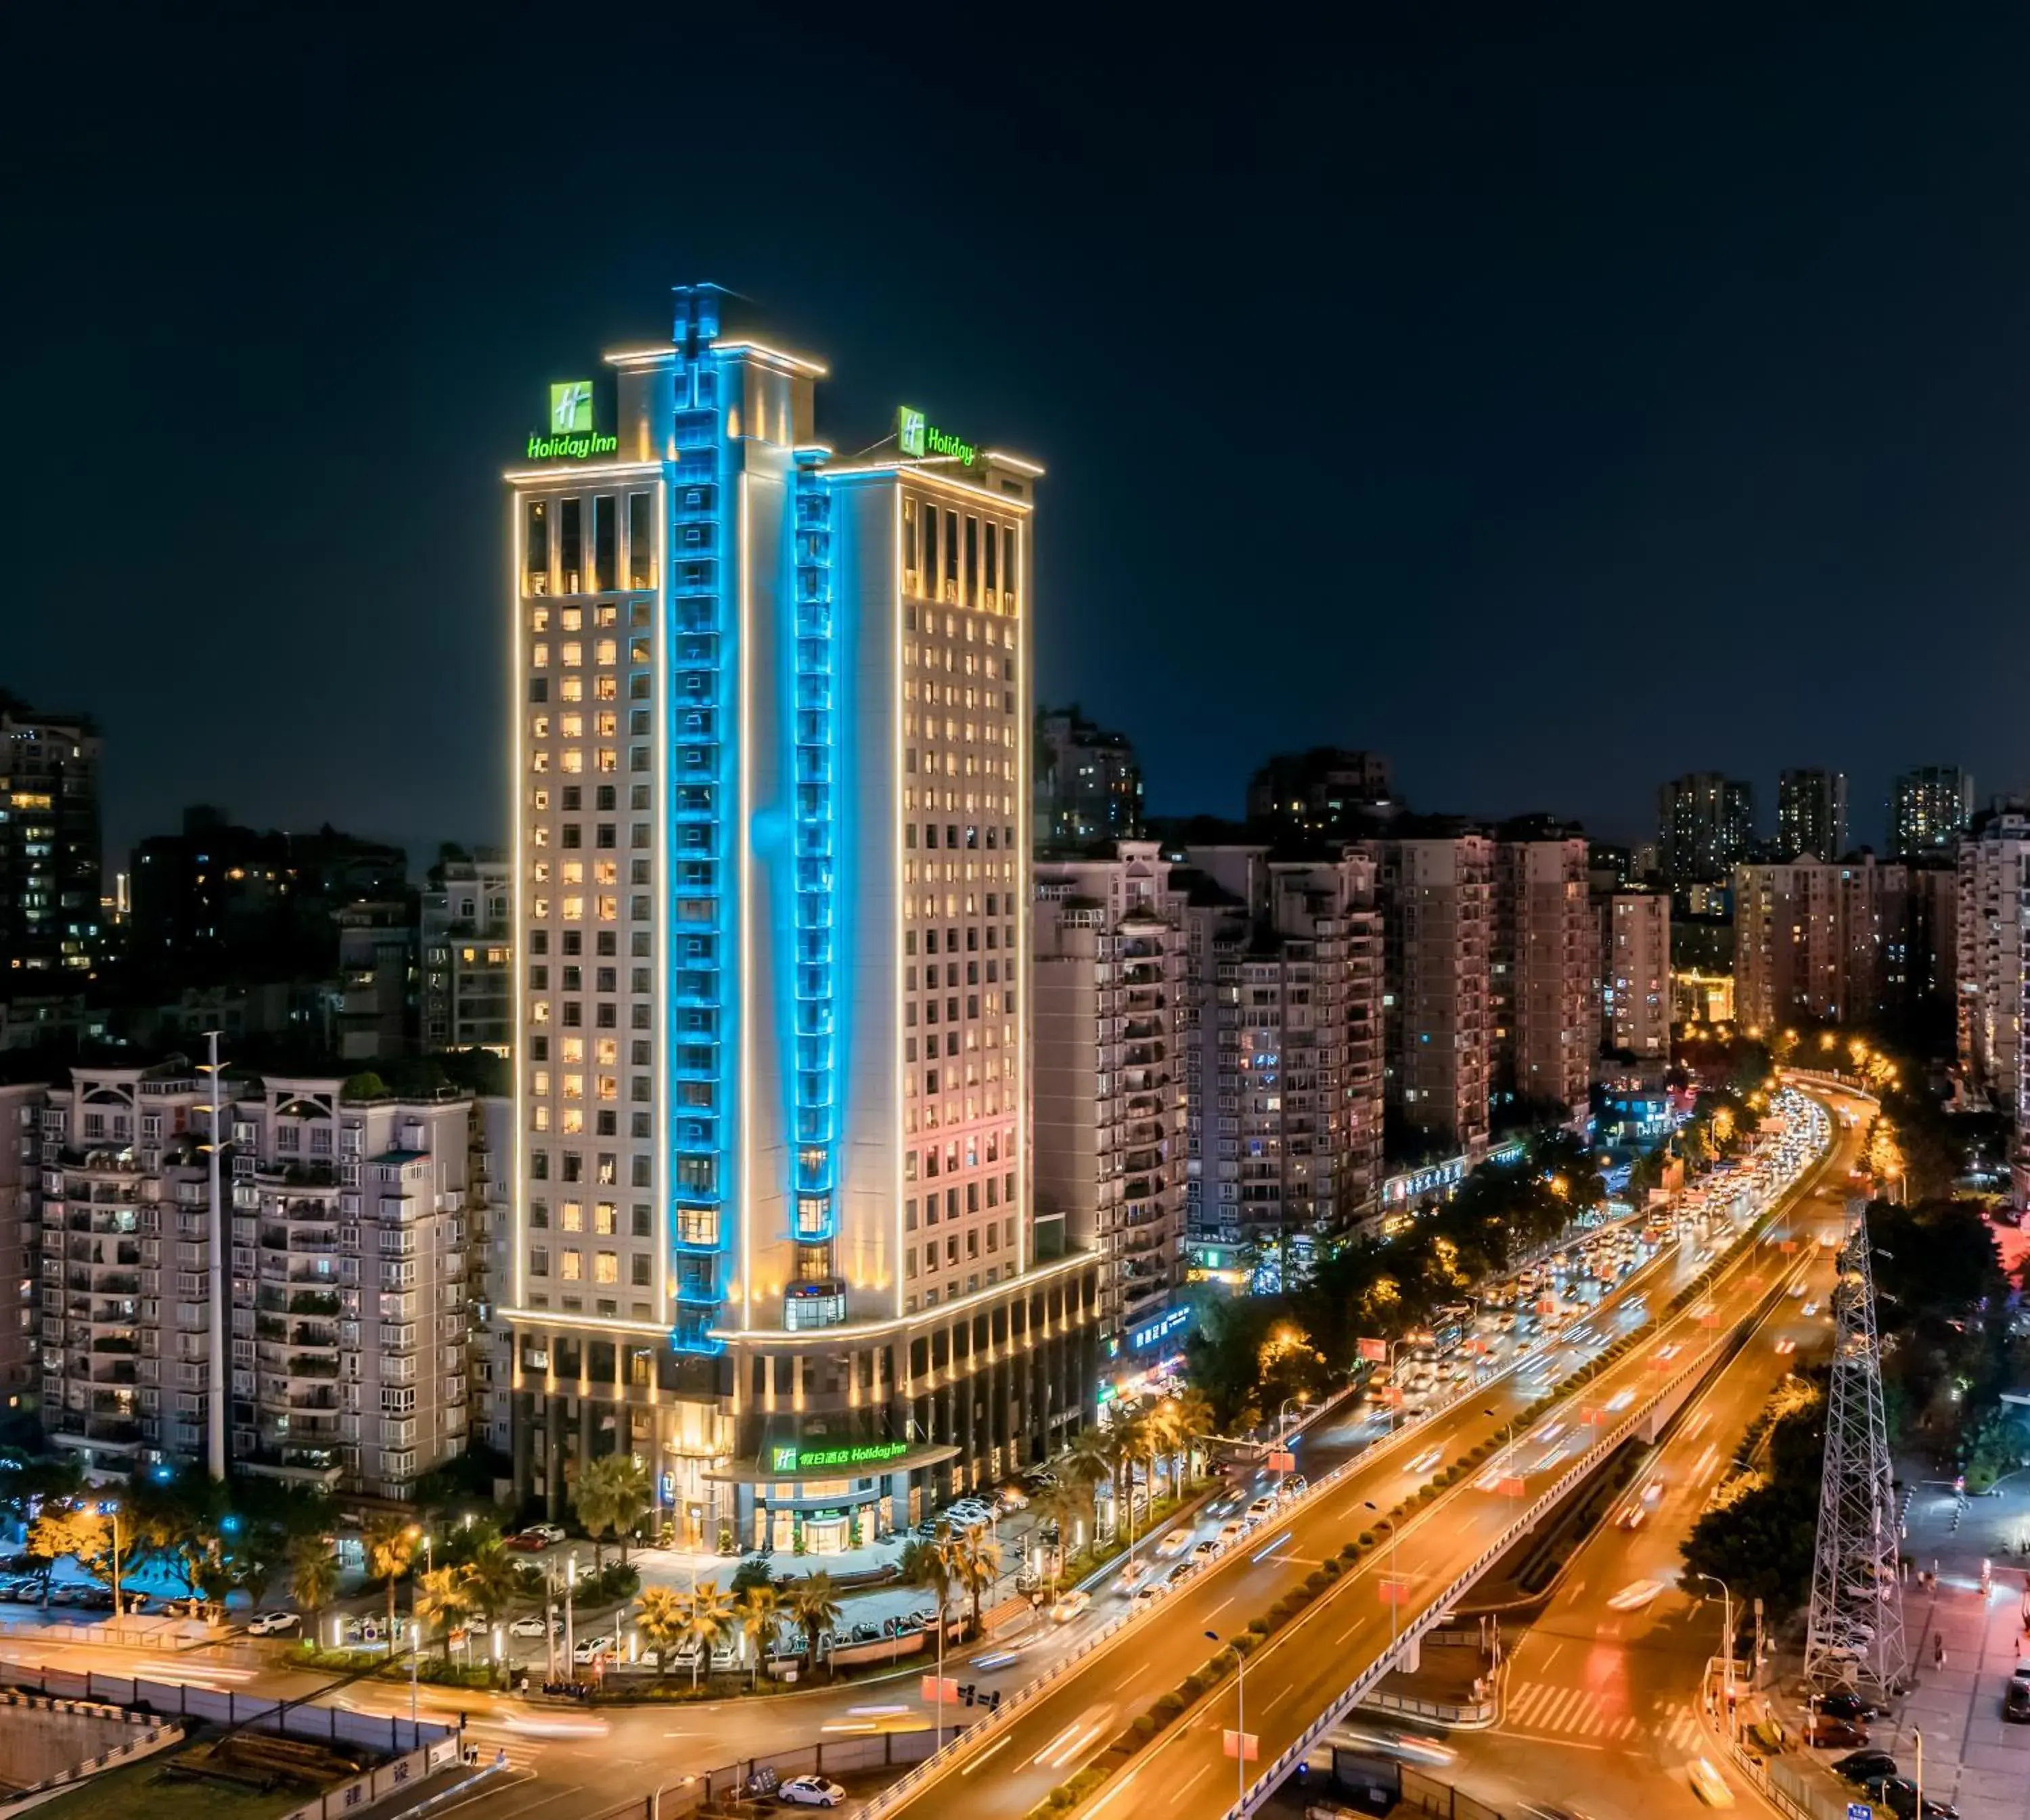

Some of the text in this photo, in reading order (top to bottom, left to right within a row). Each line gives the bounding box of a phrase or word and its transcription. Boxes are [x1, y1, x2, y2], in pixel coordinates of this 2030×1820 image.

[528, 432, 617, 458] Holiday Inn
[928, 427, 974, 466] Holiday
[799, 1442, 907, 1465] 假日酒店 Holiday Inn
